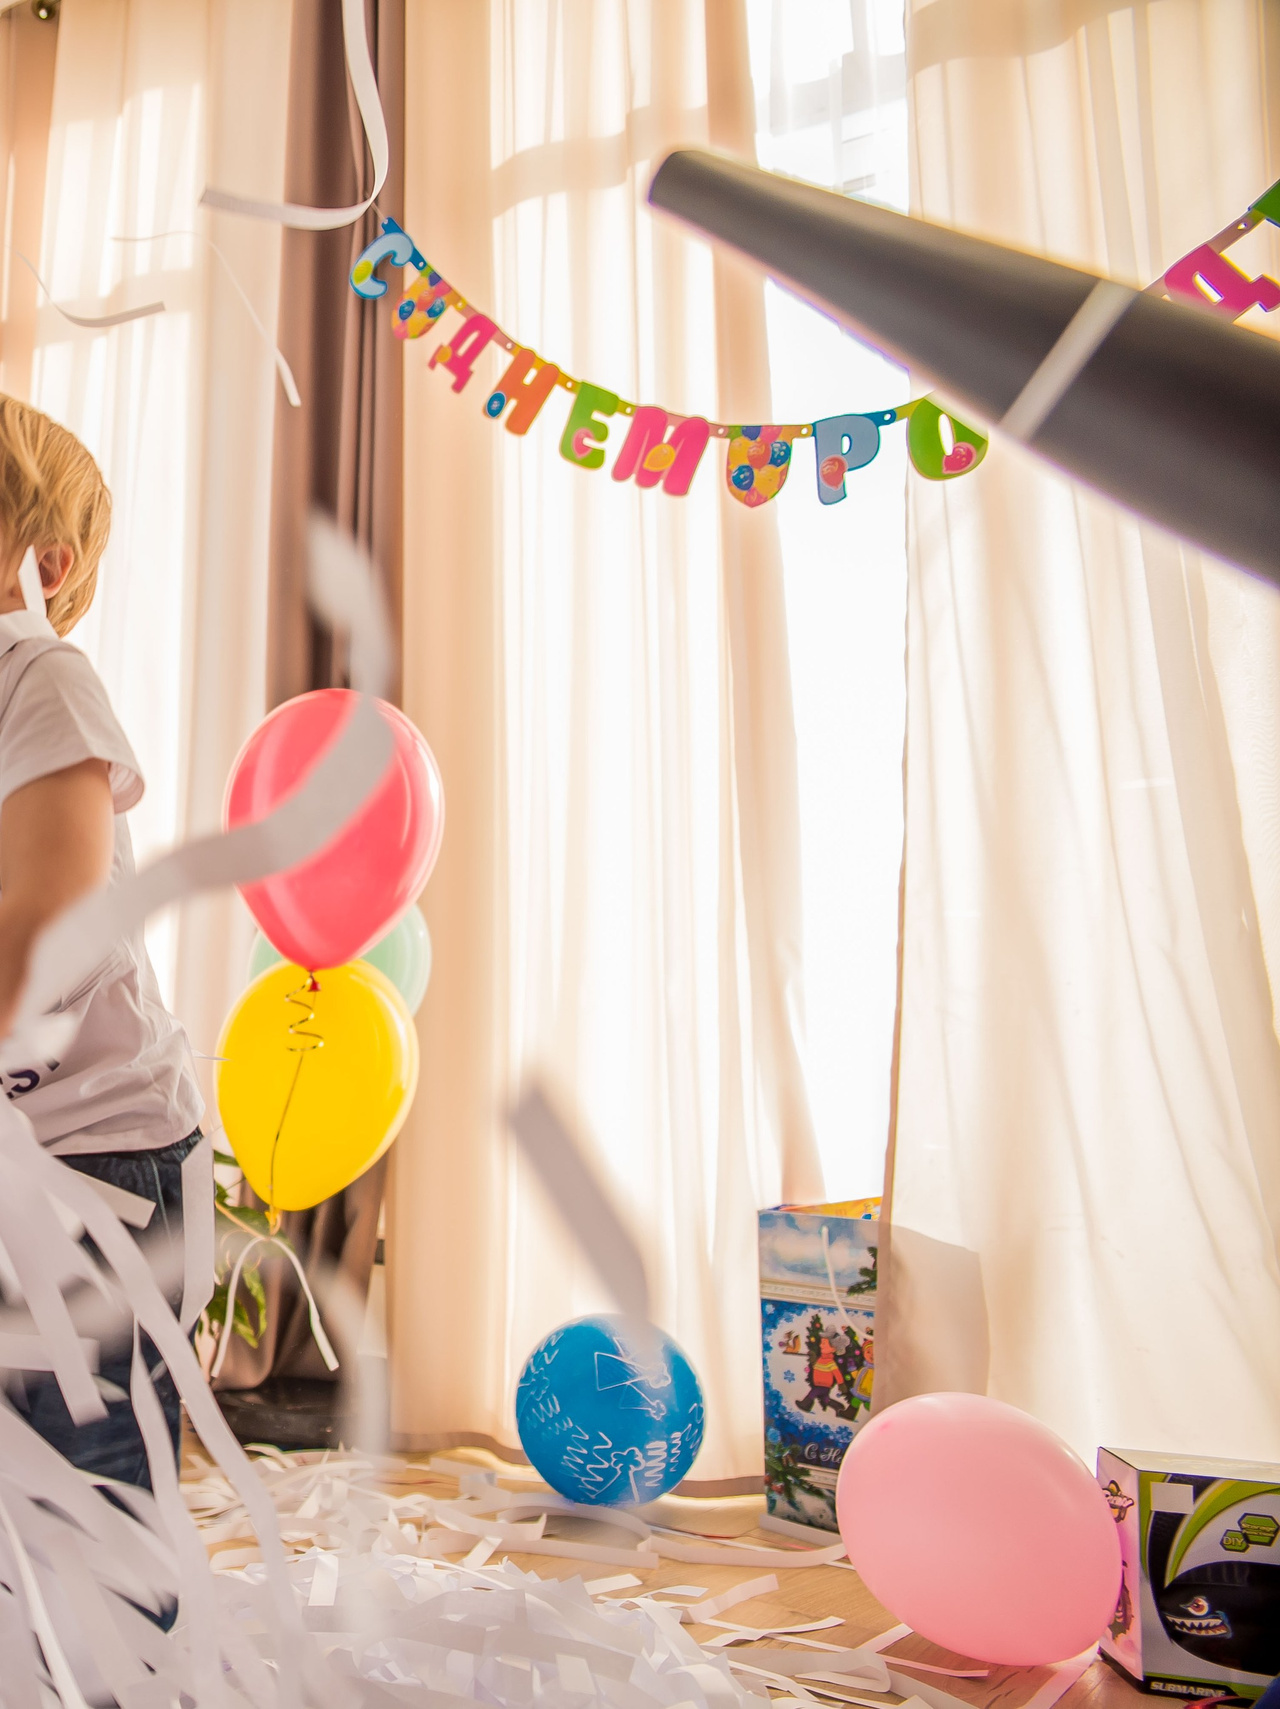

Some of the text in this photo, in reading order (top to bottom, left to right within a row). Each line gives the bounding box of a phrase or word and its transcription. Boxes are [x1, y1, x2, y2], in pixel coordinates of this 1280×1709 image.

[427, 313, 711, 498] ДНЕМ
[1223, 1536, 1244, 1547] DIY
[1150, 1680, 1227, 1698] SUBMARINE
